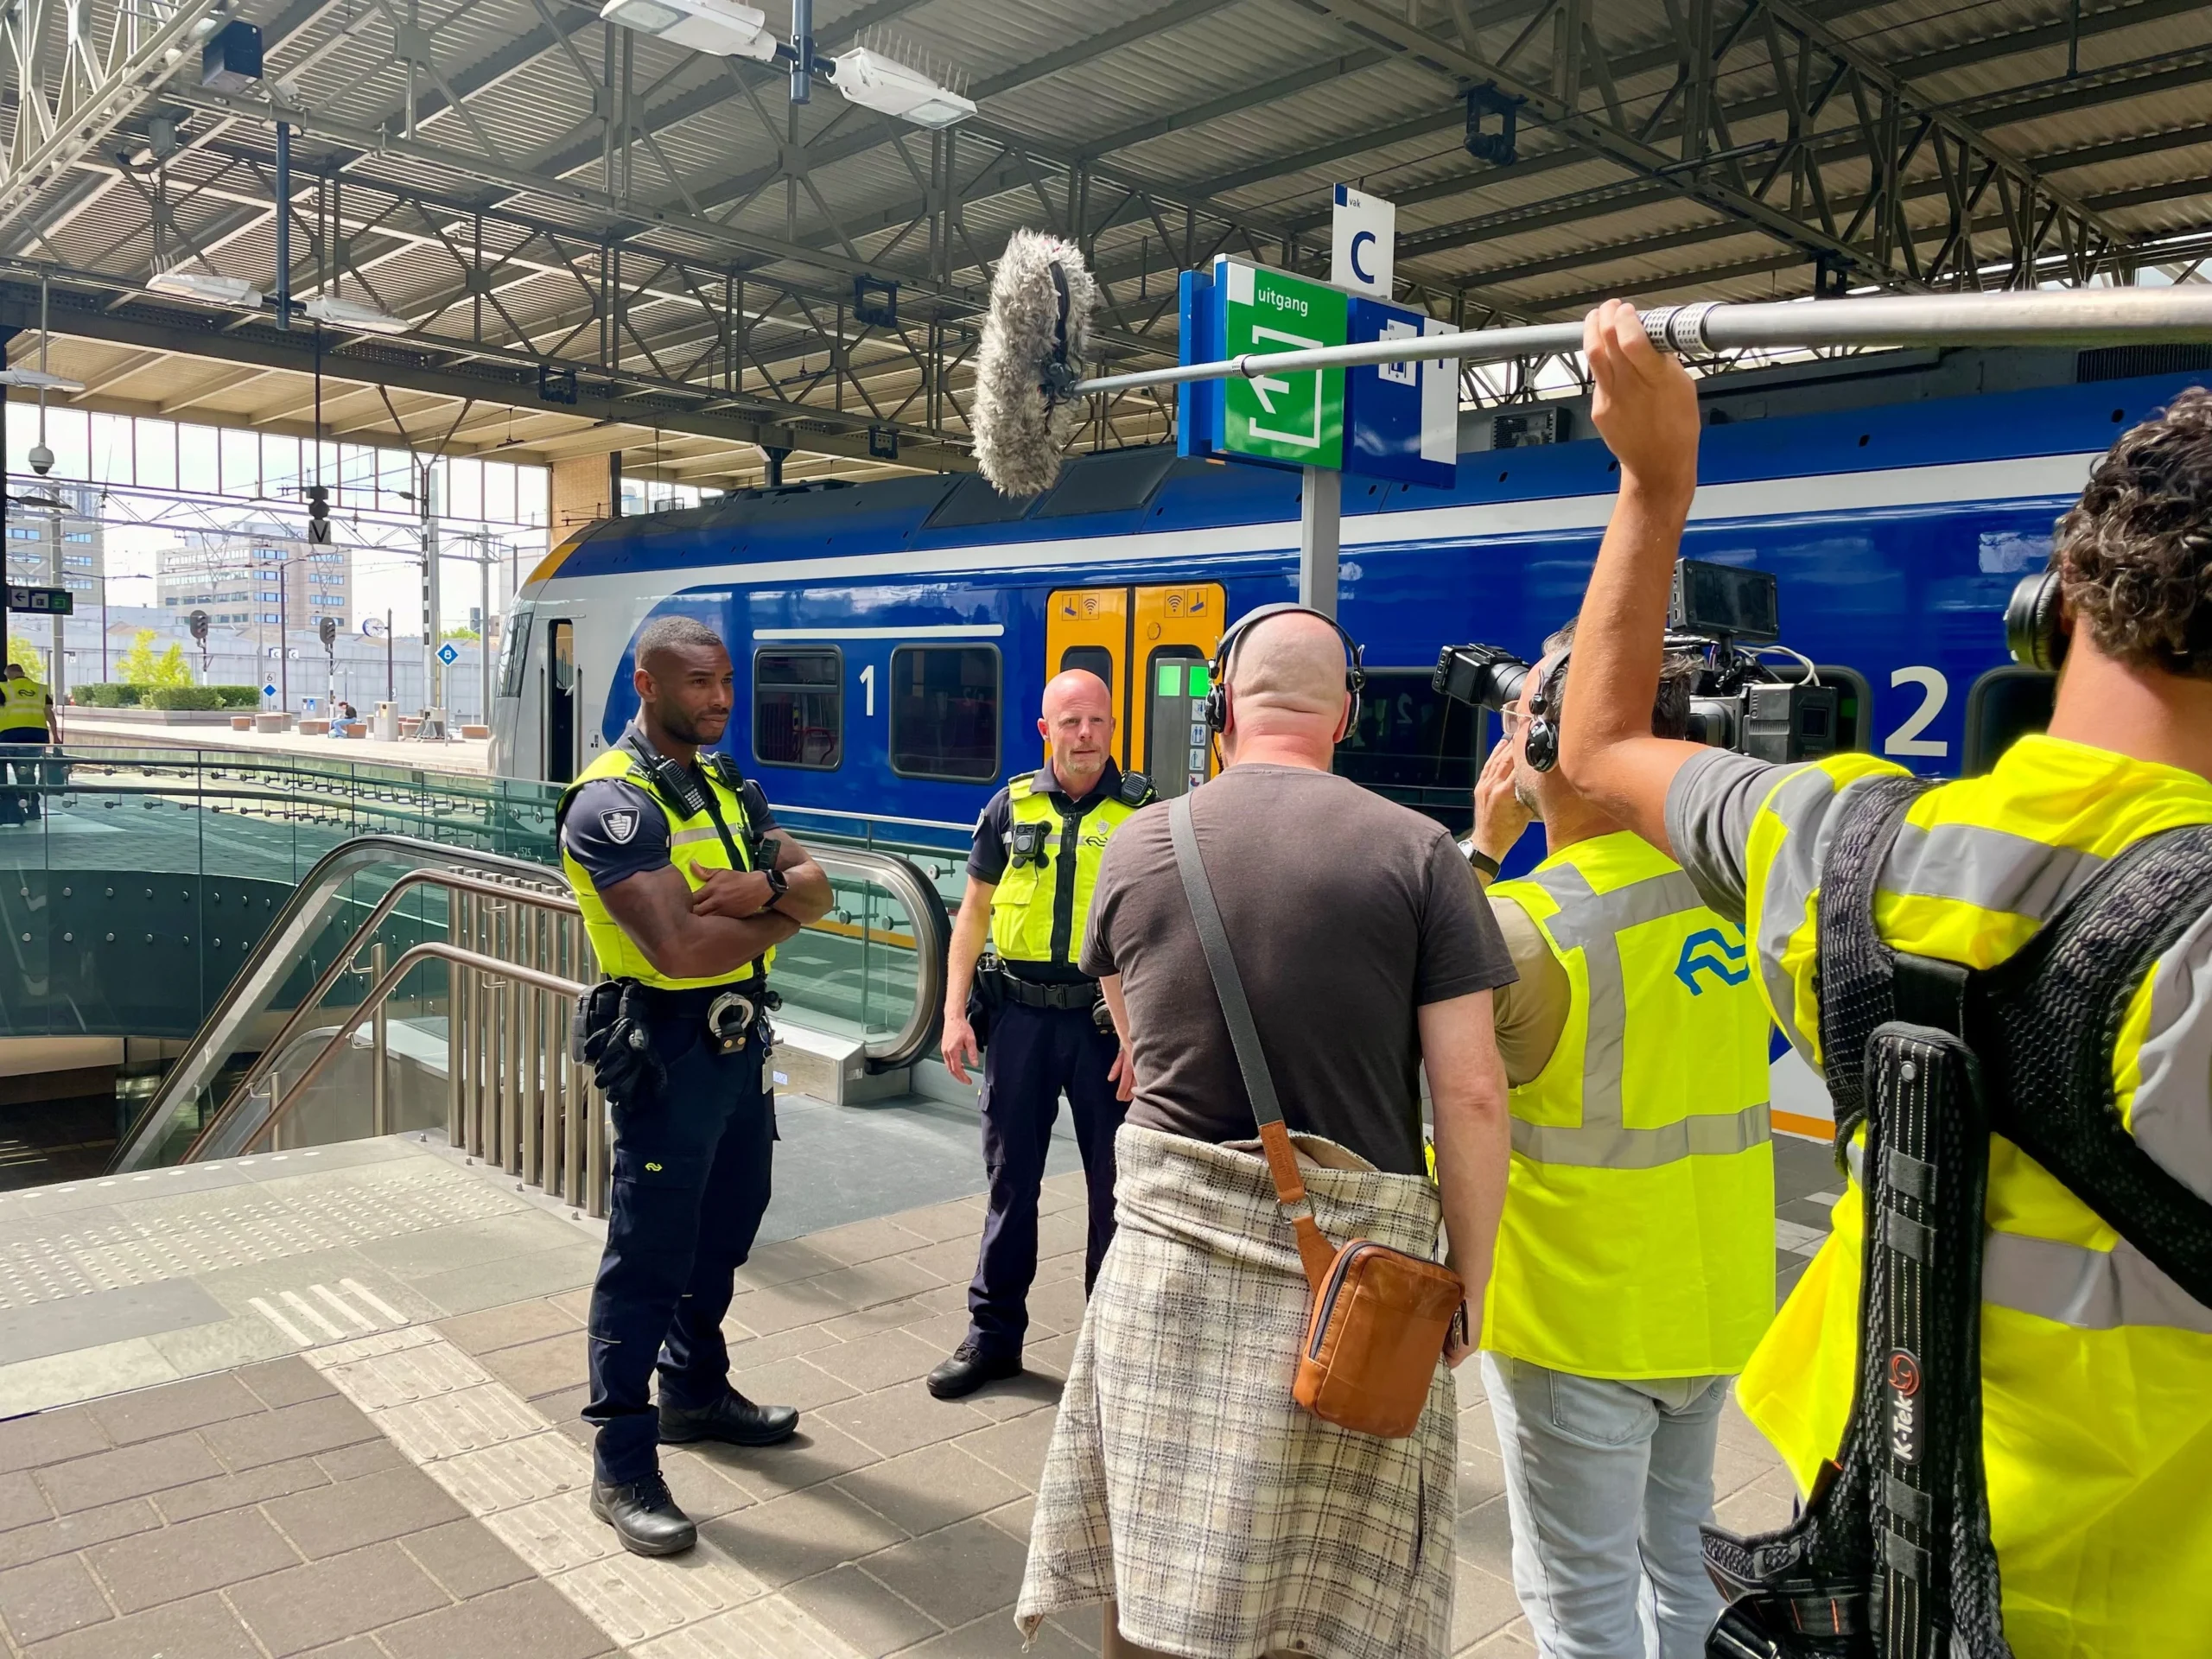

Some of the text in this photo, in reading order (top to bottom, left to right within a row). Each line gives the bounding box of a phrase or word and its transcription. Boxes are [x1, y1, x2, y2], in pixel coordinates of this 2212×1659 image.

[1349, 198, 1361, 207] vak
[1351, 231, 1376, 284] C
[1258, 287, 1308, 317] uitgang
[311, 520, 328, 543] V
[444, 650, 452, 659] 8
[266, 673, 273, 682] 6
[859, 664, 874, 716] 1
[1885, 665, 1948, 757] 2
[1892, 1390, 1913, 1460] K-Tek
